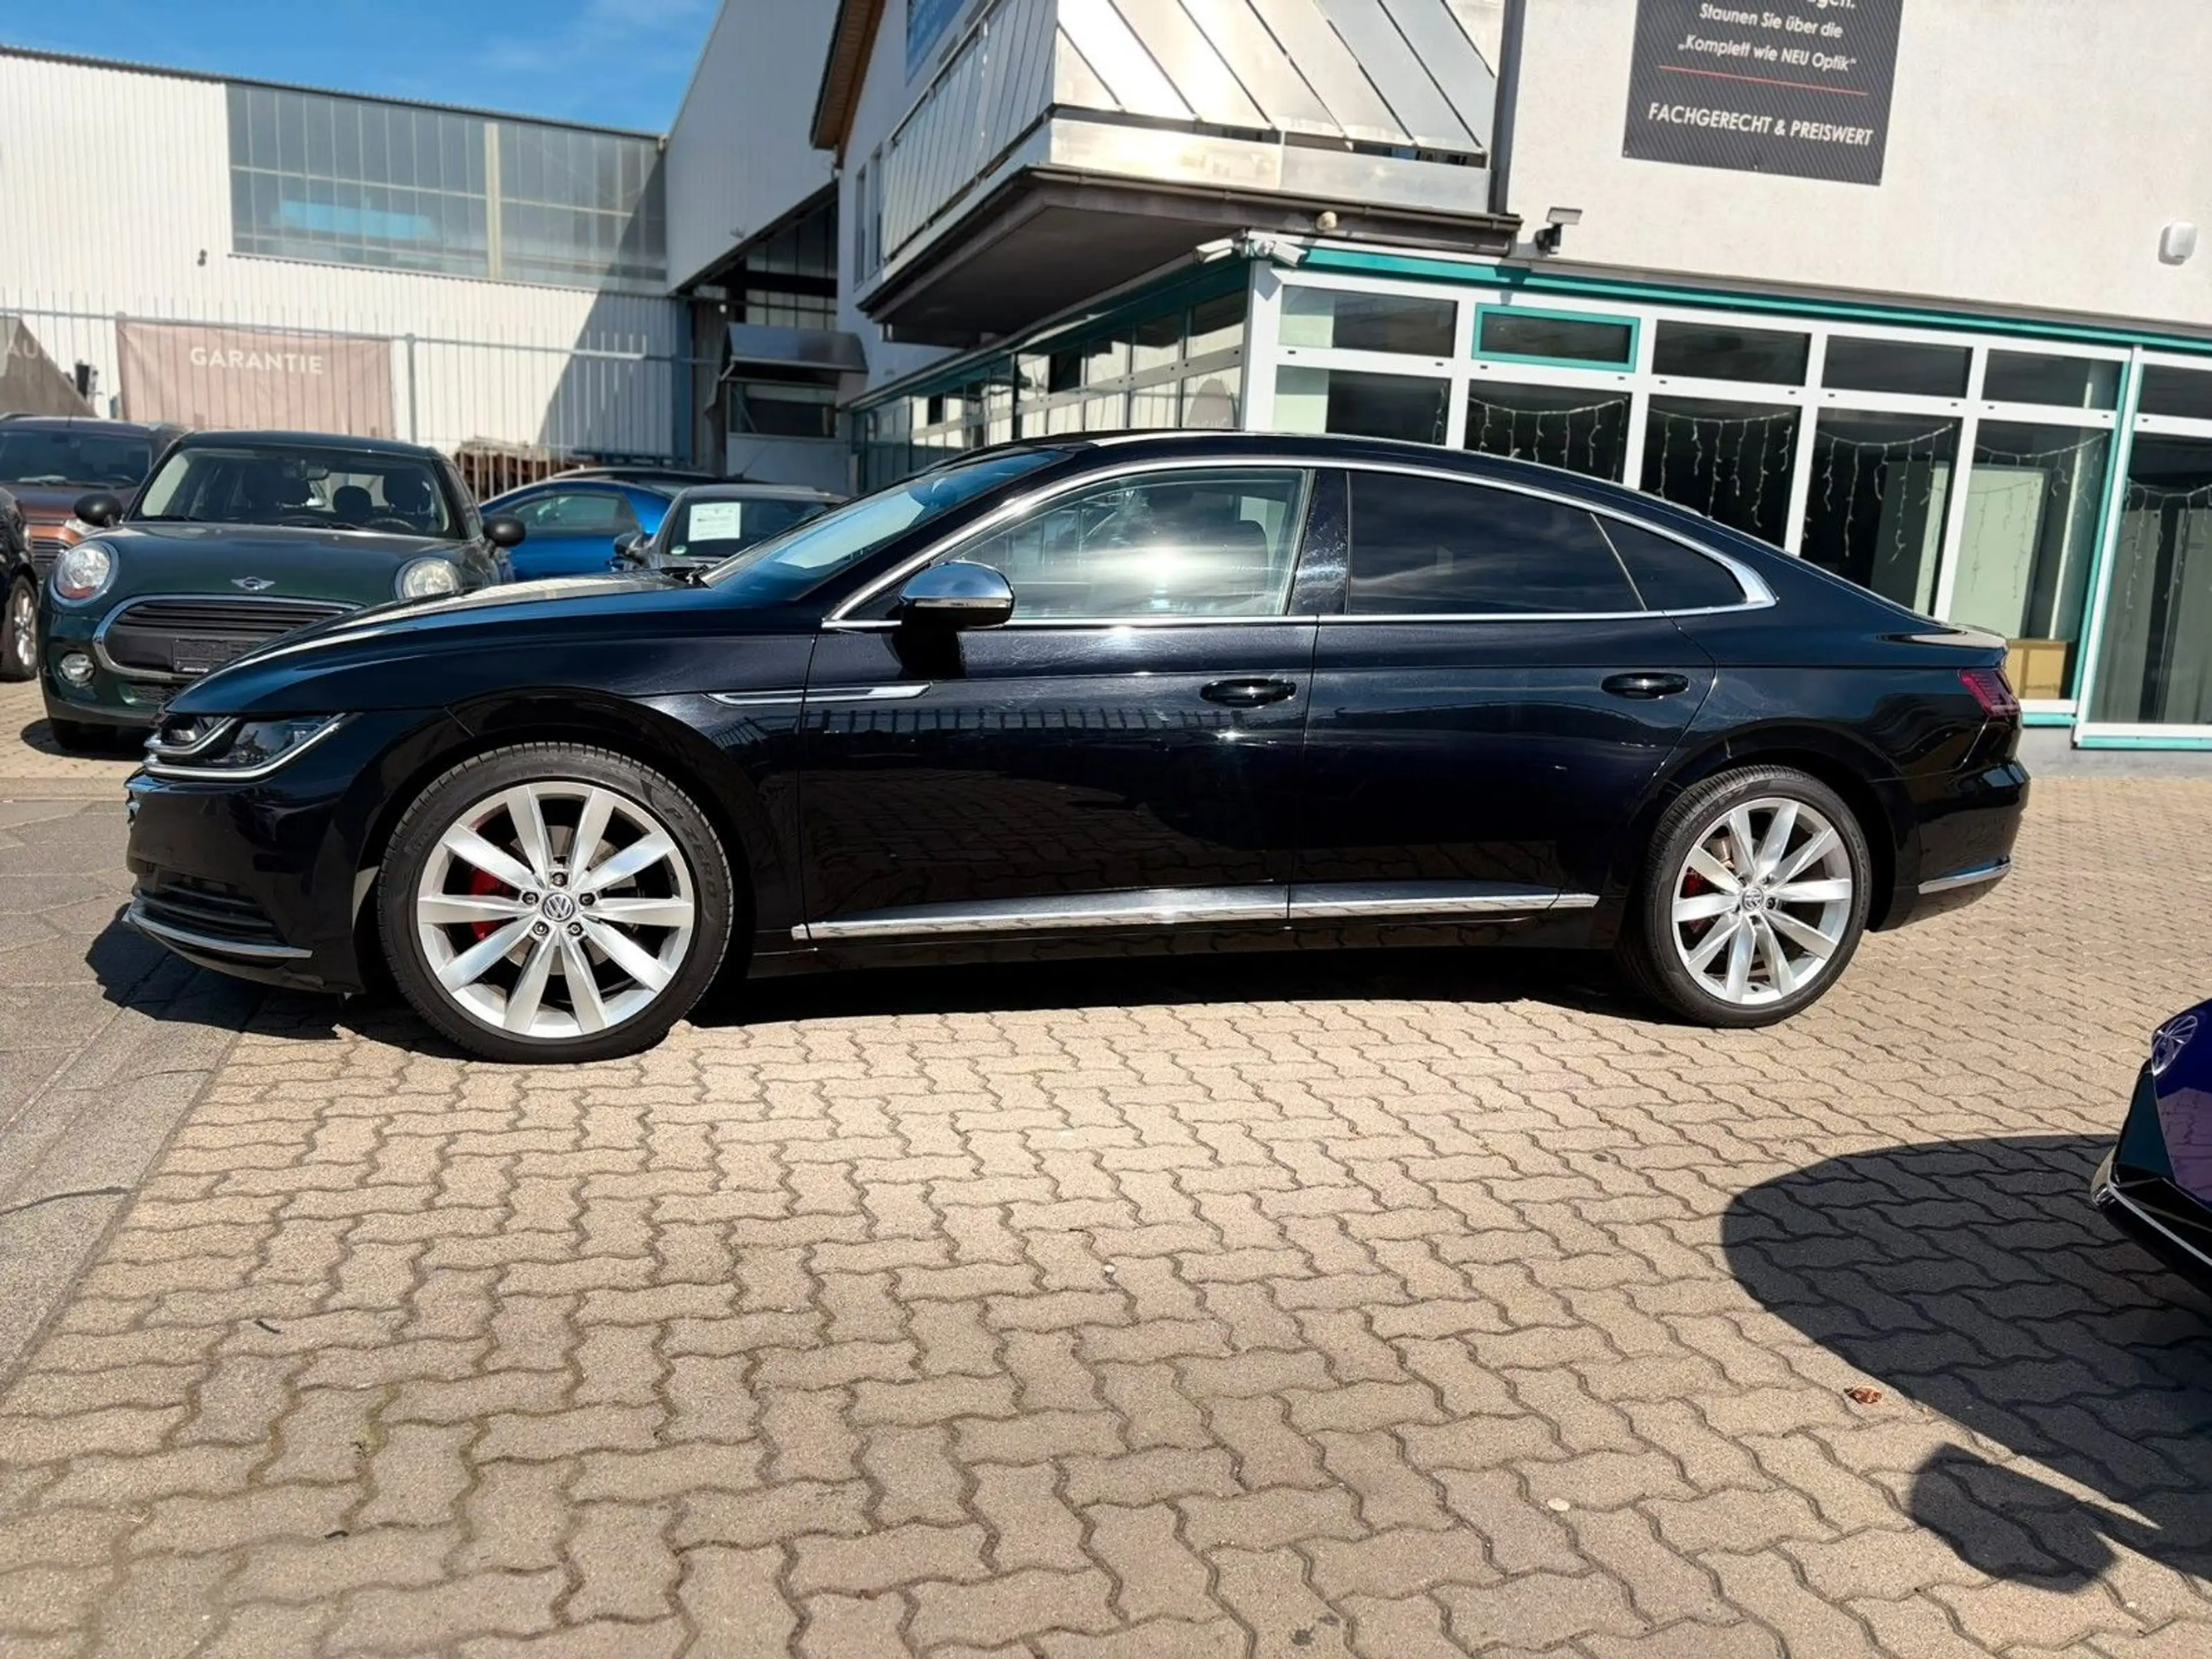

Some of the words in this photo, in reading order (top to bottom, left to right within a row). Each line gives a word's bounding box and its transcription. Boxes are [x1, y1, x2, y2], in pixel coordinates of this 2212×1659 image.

[1699, 3, 1758, 26] Staunen
[1760, 12, 1782, 29] Sie
[1786, 15, 1818, 34] über
[1820, 21, 1843, 38] die
[1753, 44, 1778, 61] wie
[1781, 47, 1809, 66] NEU
[1648, 102, 1772, 134] FACHGERECHT
[1774, 119, 1786, 137] &
[1789, 120, 1873, 146] PREISWERT
[190, 347, 323, 374] GARANTIE
